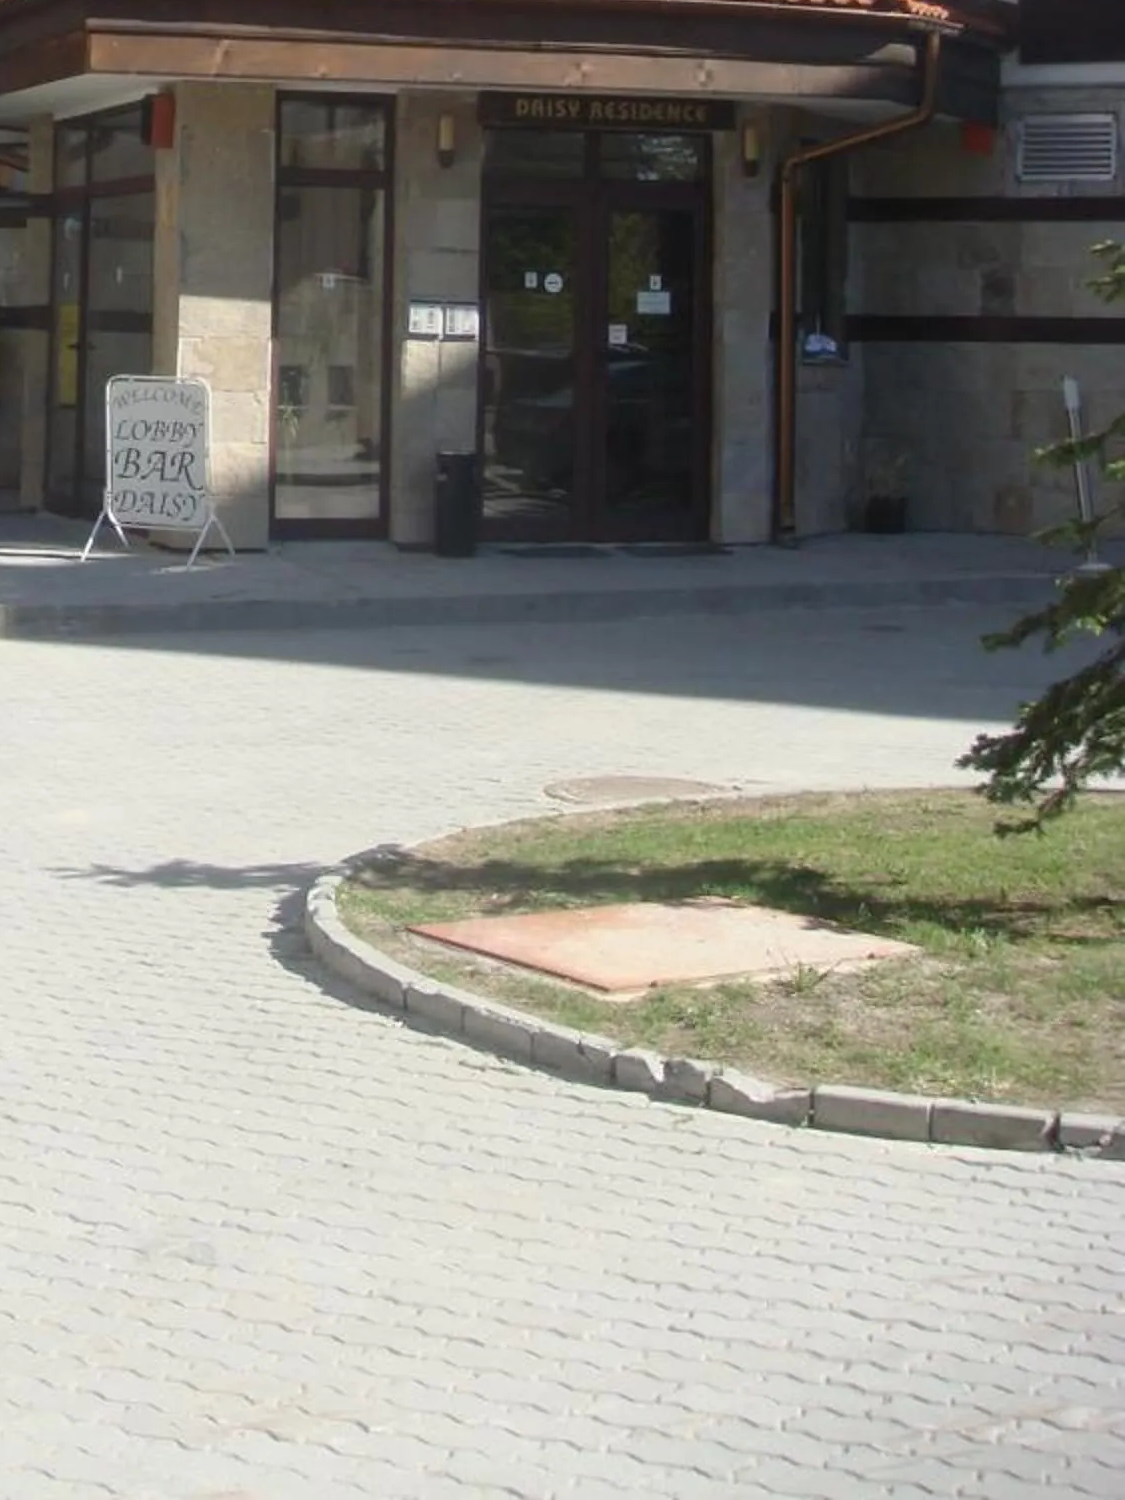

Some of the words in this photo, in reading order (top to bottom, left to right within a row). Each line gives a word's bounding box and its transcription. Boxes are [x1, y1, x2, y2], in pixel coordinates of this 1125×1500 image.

[515, 98, 581, 118] DAISY
[114, 386, 204, 414] WELCOME
[115, 419, 203, 448] LOBBY
[114, 447, 203, 490] BAR
[114, 489, 205, 521] DAISY
